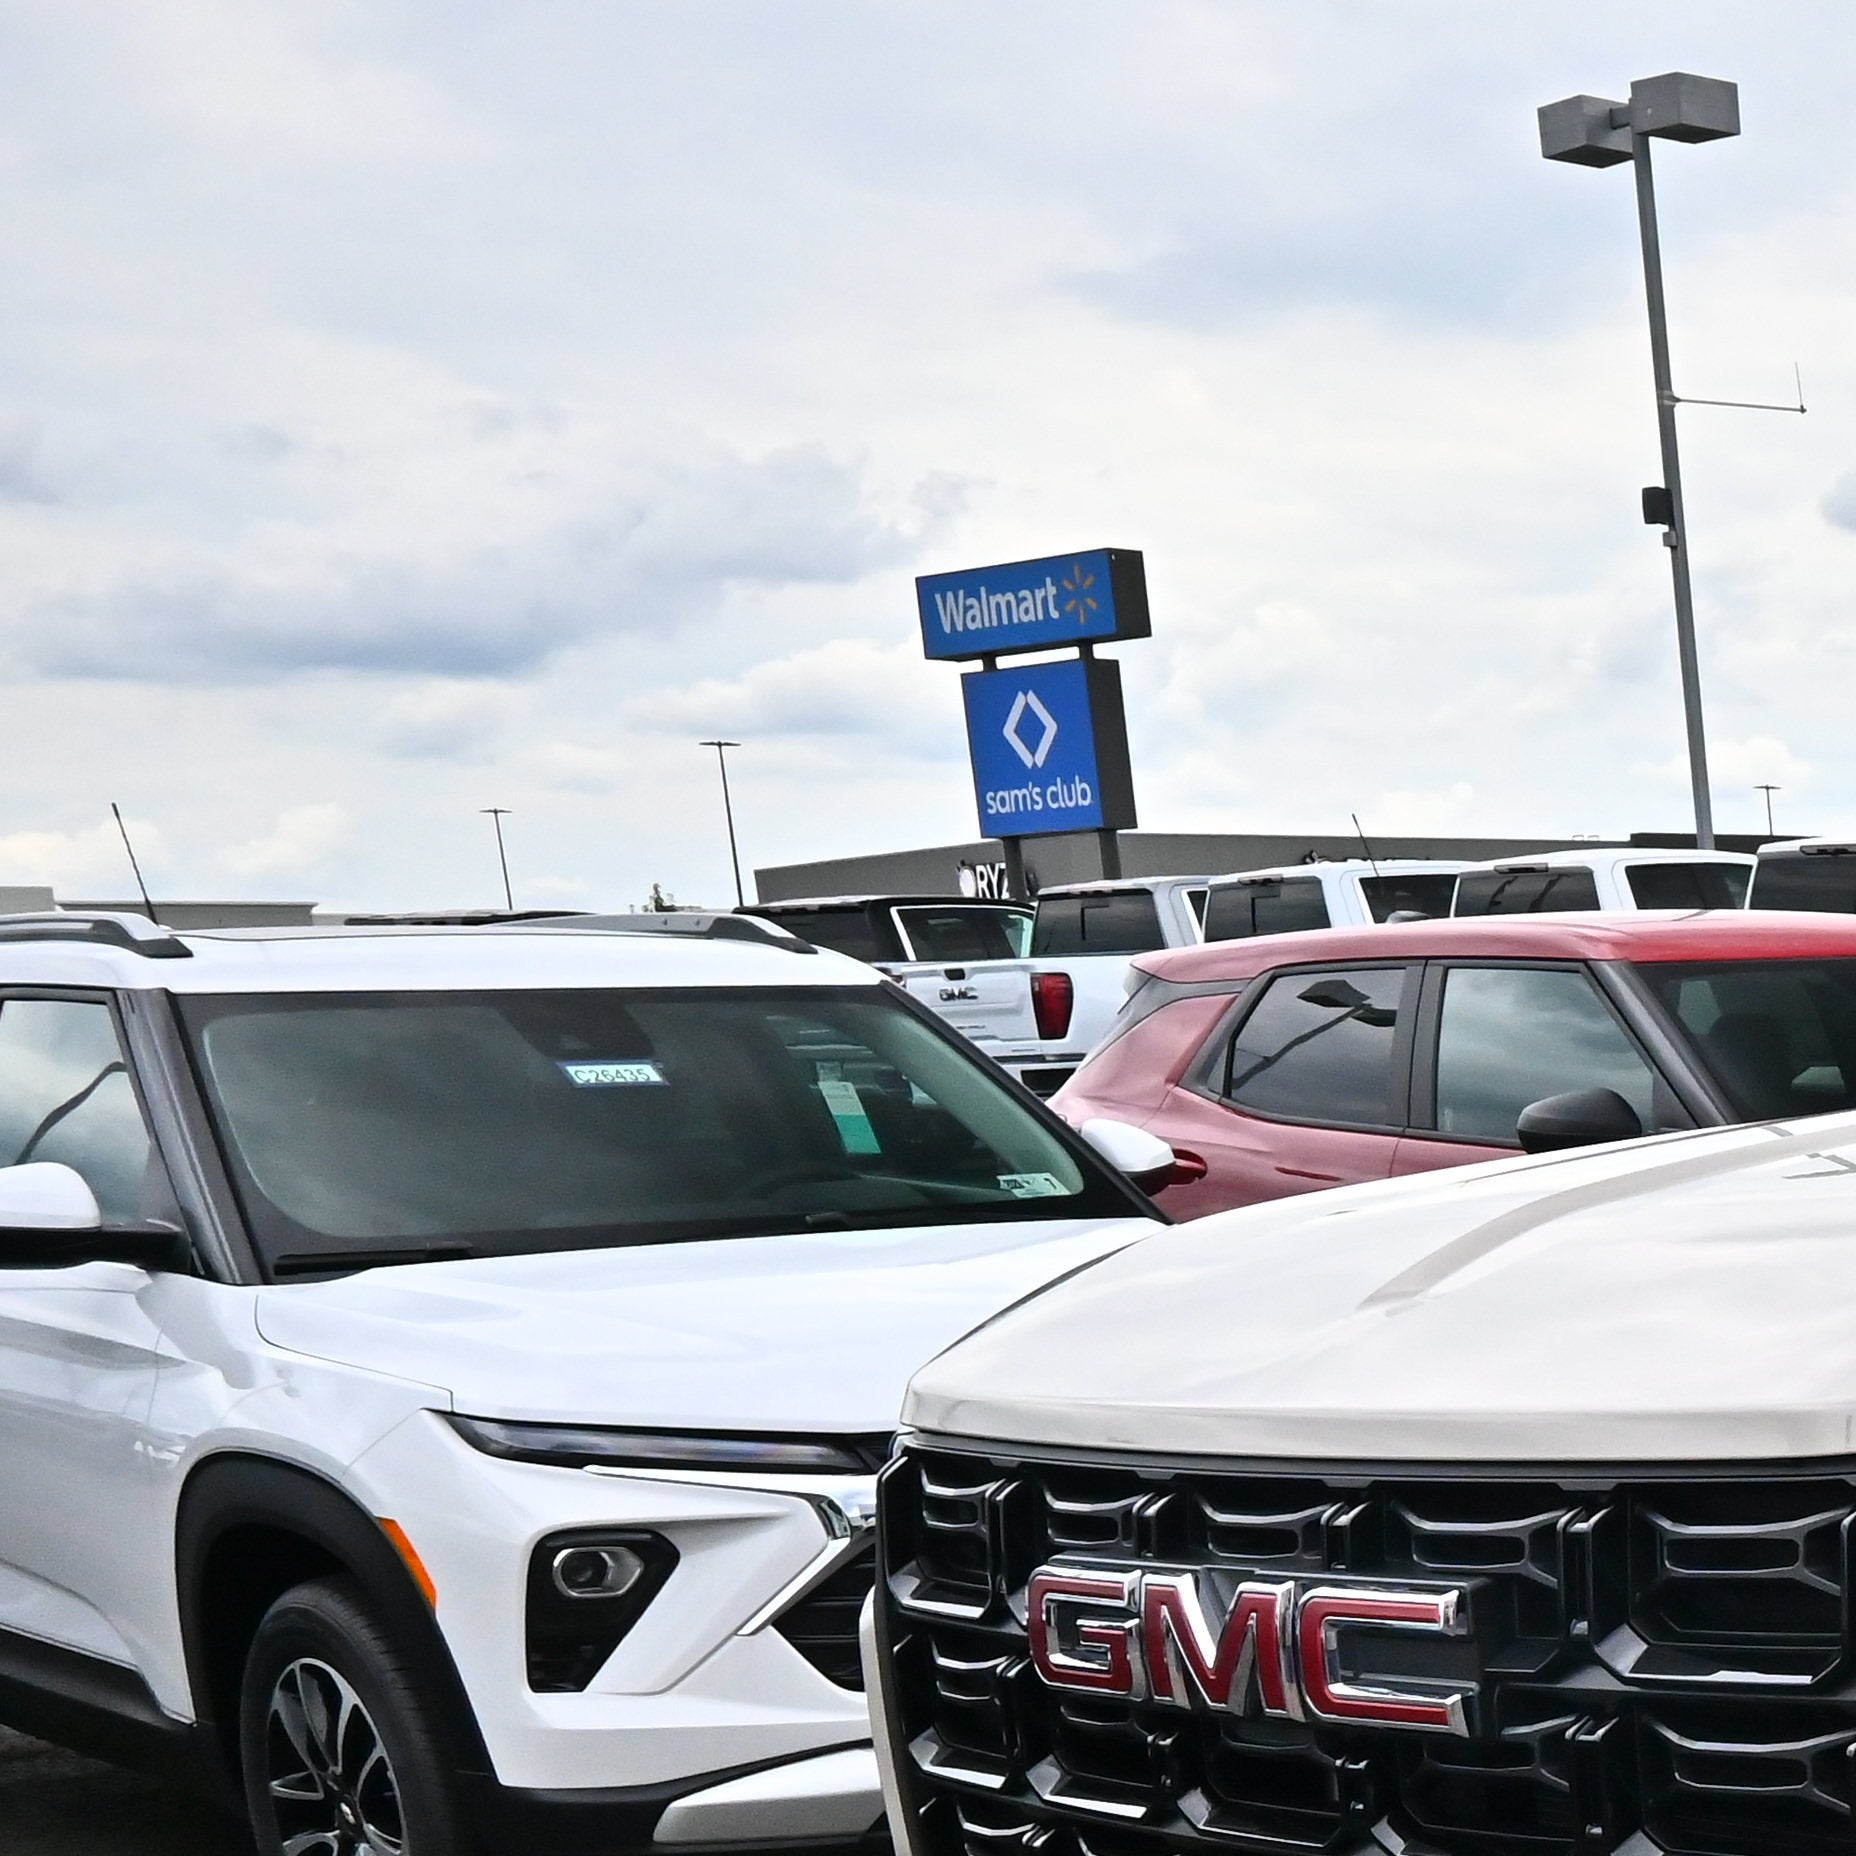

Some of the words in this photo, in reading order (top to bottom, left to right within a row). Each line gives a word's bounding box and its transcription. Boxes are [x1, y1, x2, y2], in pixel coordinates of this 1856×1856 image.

[935, 577, 1060, 634] Walmart
[985, 781, 1043, 814] sam's
[1046, 774, 1092, 809] club
[939, 986, 979, 1001] GMC
[574, 1067, 651, 1083] C26435
[1026, 1564, 1471, 1738] GMC
